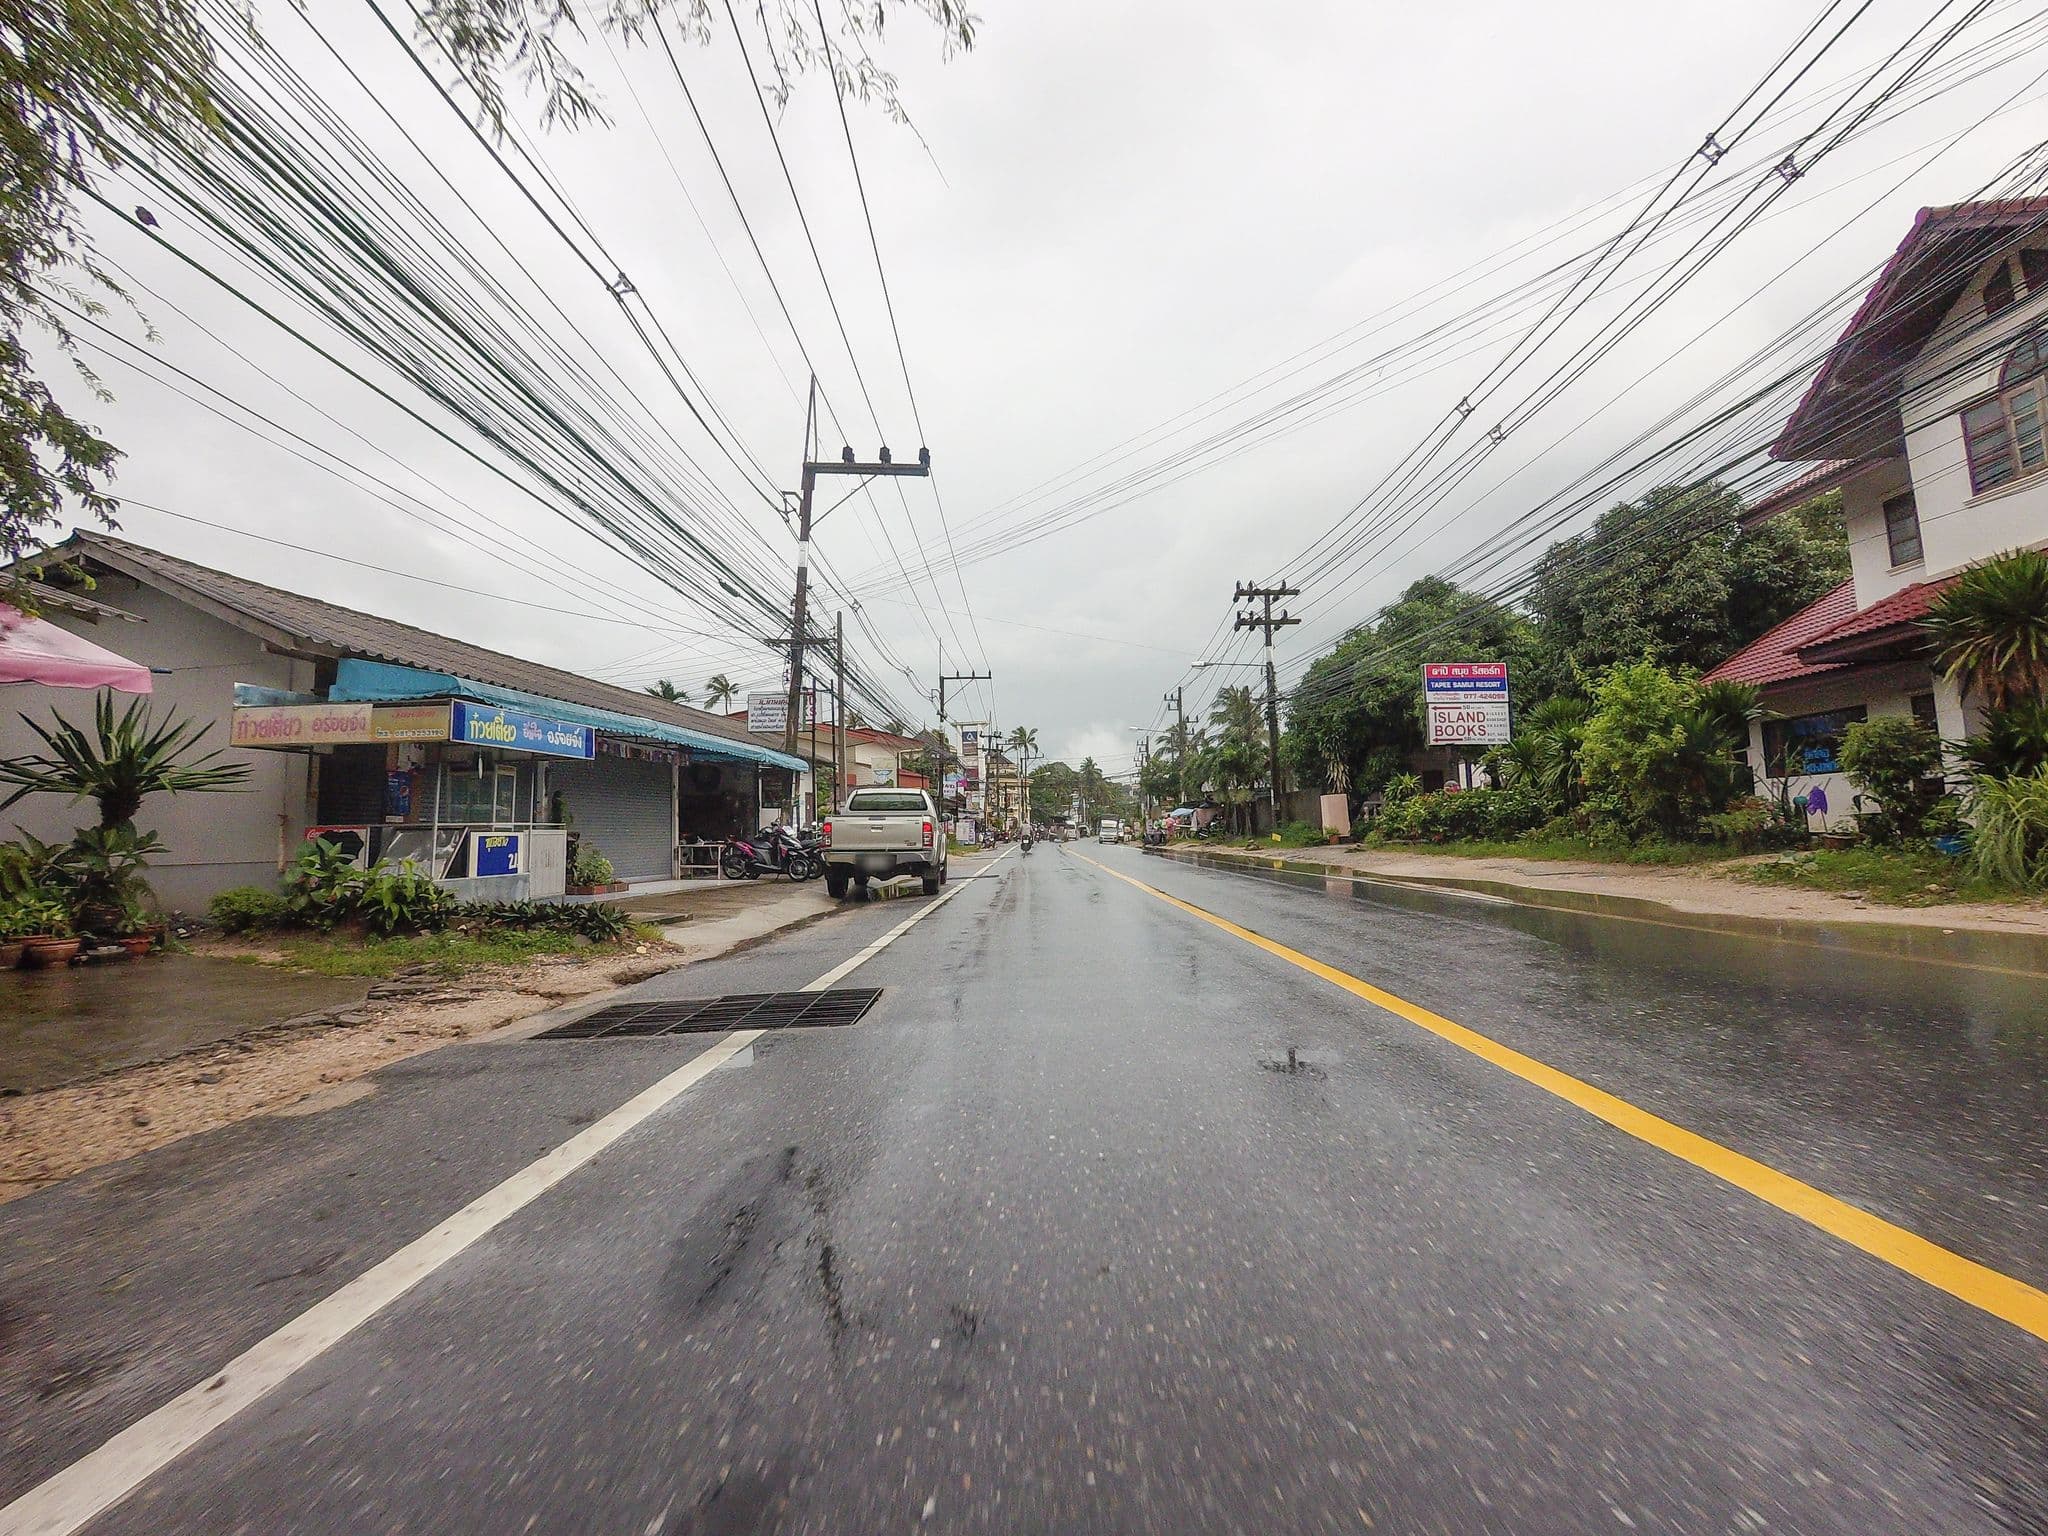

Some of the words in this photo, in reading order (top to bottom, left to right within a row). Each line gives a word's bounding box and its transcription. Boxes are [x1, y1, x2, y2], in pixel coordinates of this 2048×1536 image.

[1452, 667, 1469, 678] สมุย
[1434, 711, 1486, 723] ISLAND
[1434, 724, 1487, 737] BOOKS
